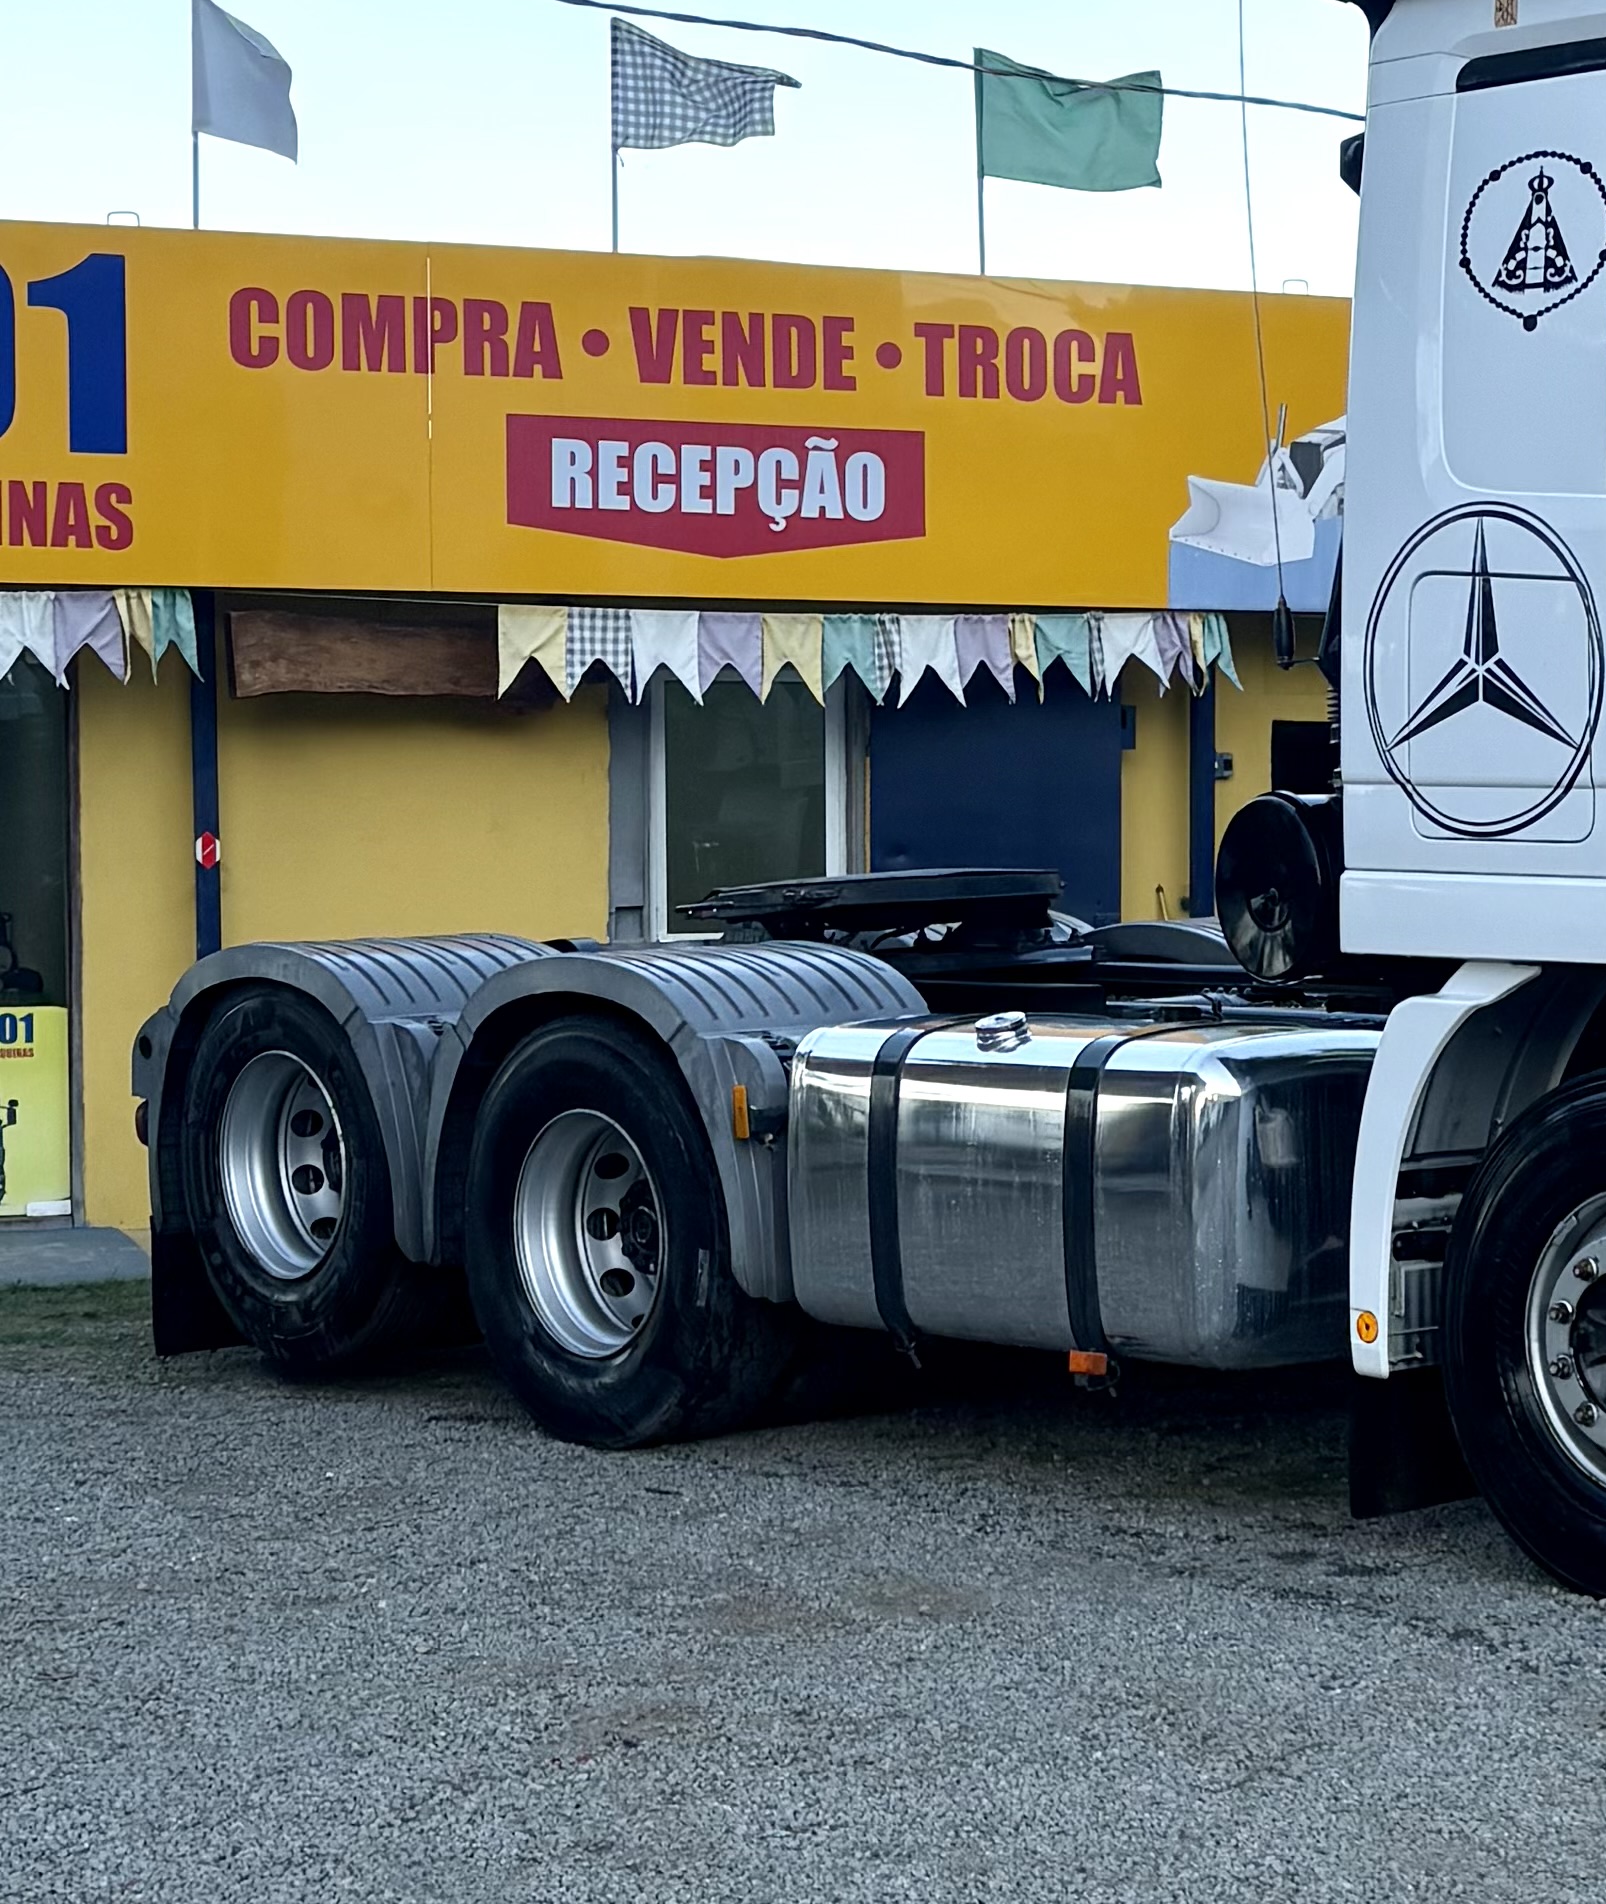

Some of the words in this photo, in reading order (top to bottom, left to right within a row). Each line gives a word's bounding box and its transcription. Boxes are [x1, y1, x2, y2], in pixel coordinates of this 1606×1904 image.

[0, 252, 127, 455] 1
[229, 286, 563, 380] COMPRA
[629, 307, 857, 391] VENDE
[914, 322, 1142, 405] TROCA
[0, 479, 134, 551] NAS
[551, 436, 887, 532] RECEPÇÃO
[0, 1012, 34, 1044] 01
